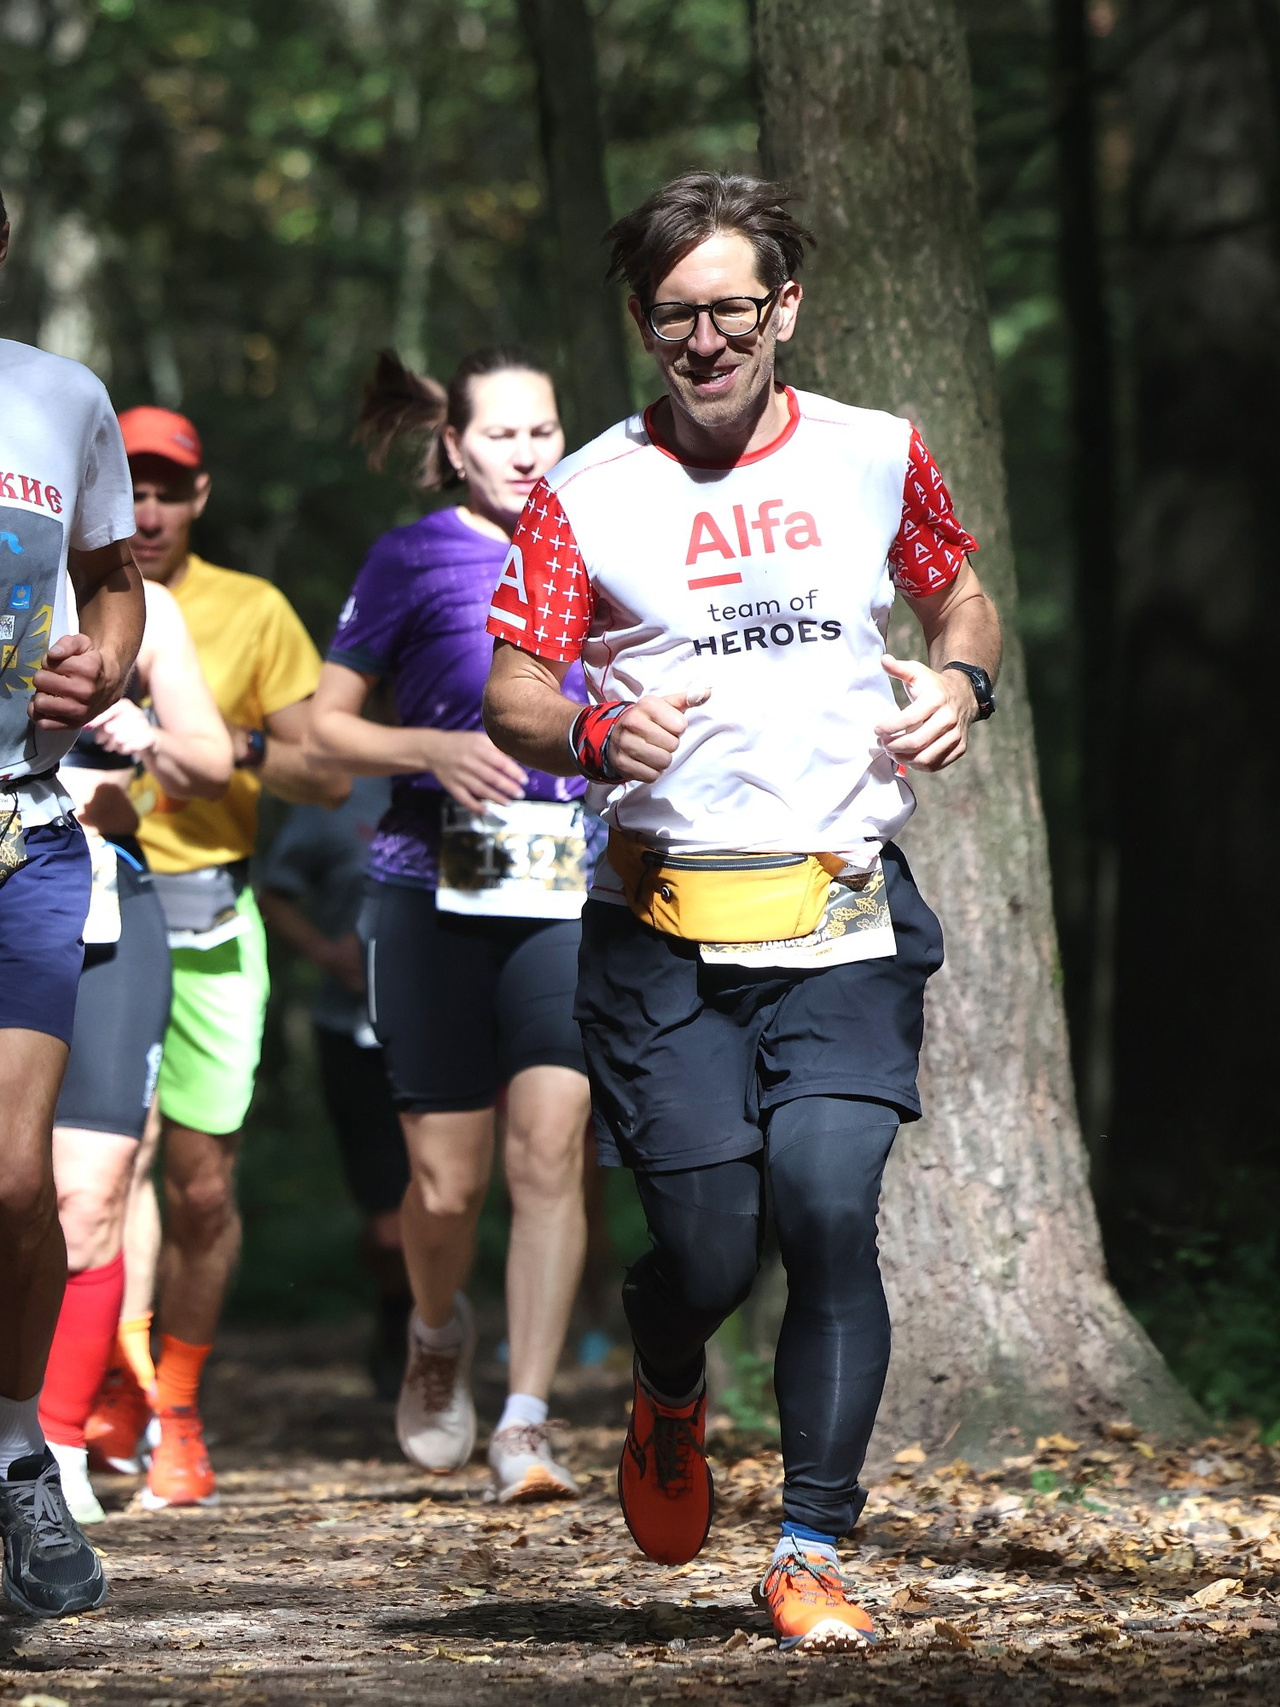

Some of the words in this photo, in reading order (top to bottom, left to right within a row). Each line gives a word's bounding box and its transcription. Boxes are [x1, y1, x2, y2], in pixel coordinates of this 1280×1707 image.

[685, 499, 822, 565] Alfa
[495, 544, 529, 605] A
[707, 599, 780, 622] team
[790, 589, 818, 611] of
[693, 620, 841, 656] HEROES
[477, 836, 557, 879] 132
